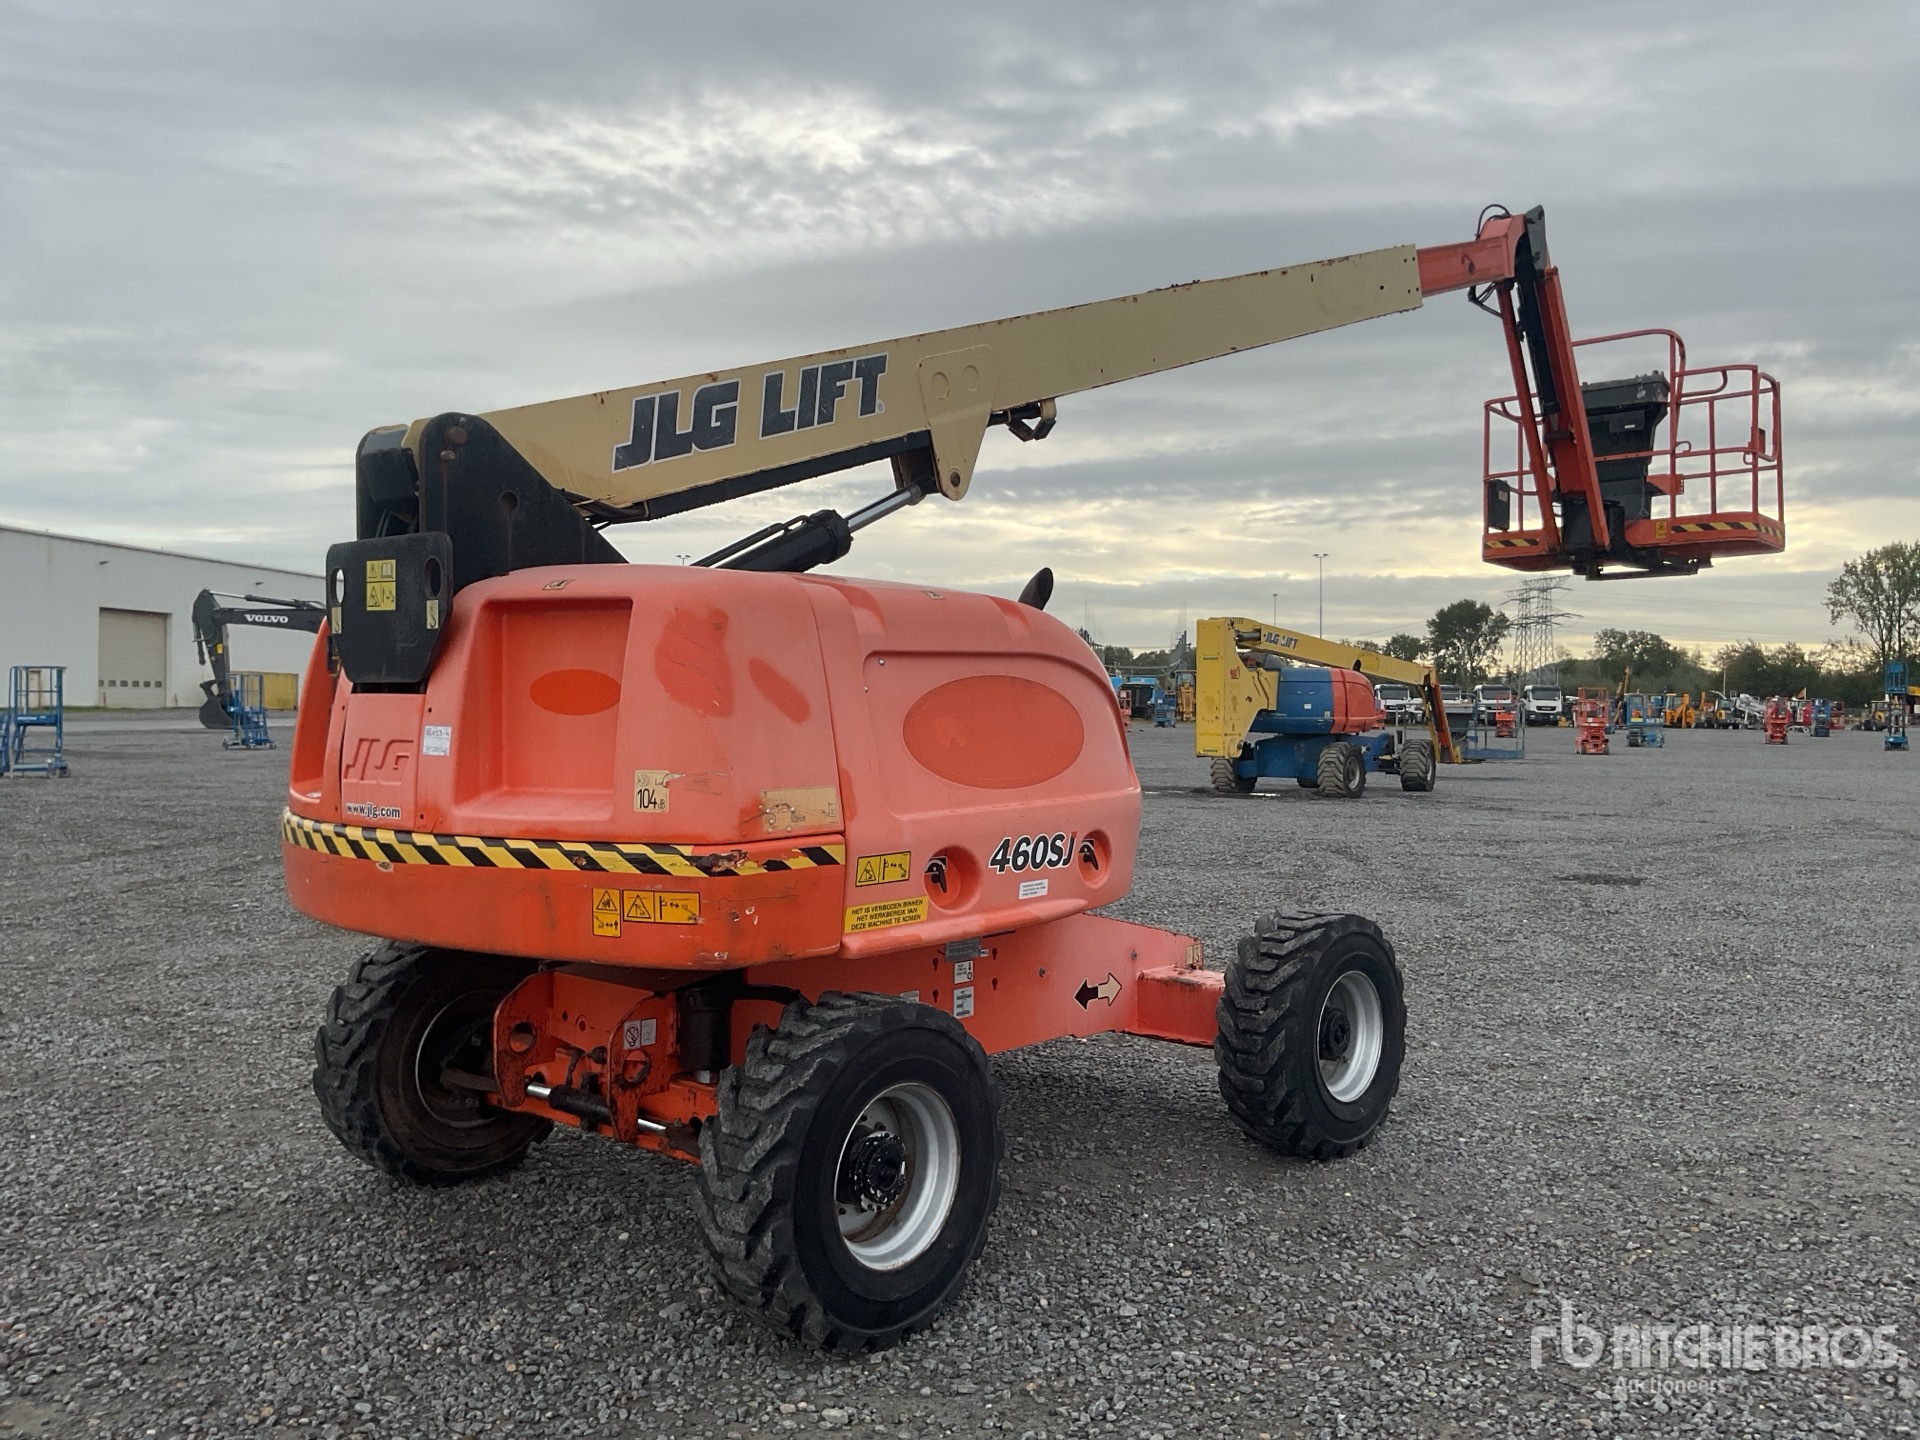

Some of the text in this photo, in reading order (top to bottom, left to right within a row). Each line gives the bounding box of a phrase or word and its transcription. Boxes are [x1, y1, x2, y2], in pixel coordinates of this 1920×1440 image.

[612, 352, 888, 473] JLG LIFT
[244, 614, 289, 623] VOLVO
[1264, 632, 1280, 645] JLG
[343, 738, 414, 785] JLG
[637, 788, 657, 809] 104
[347, 804, 400, 818] www.jlg.com
[990, 832, 1076, 873] 460SJ
[871, 902, 903, 912] VERBODEN
[903, 899, 924, 908] BINNEN
[869, 909, 906, 920] WERKBEREIK
[851, 923, 866, 931] DEZE
[867, 918, 893, 928] MACHINE
[902, 914, 922, 922] KOMEN
